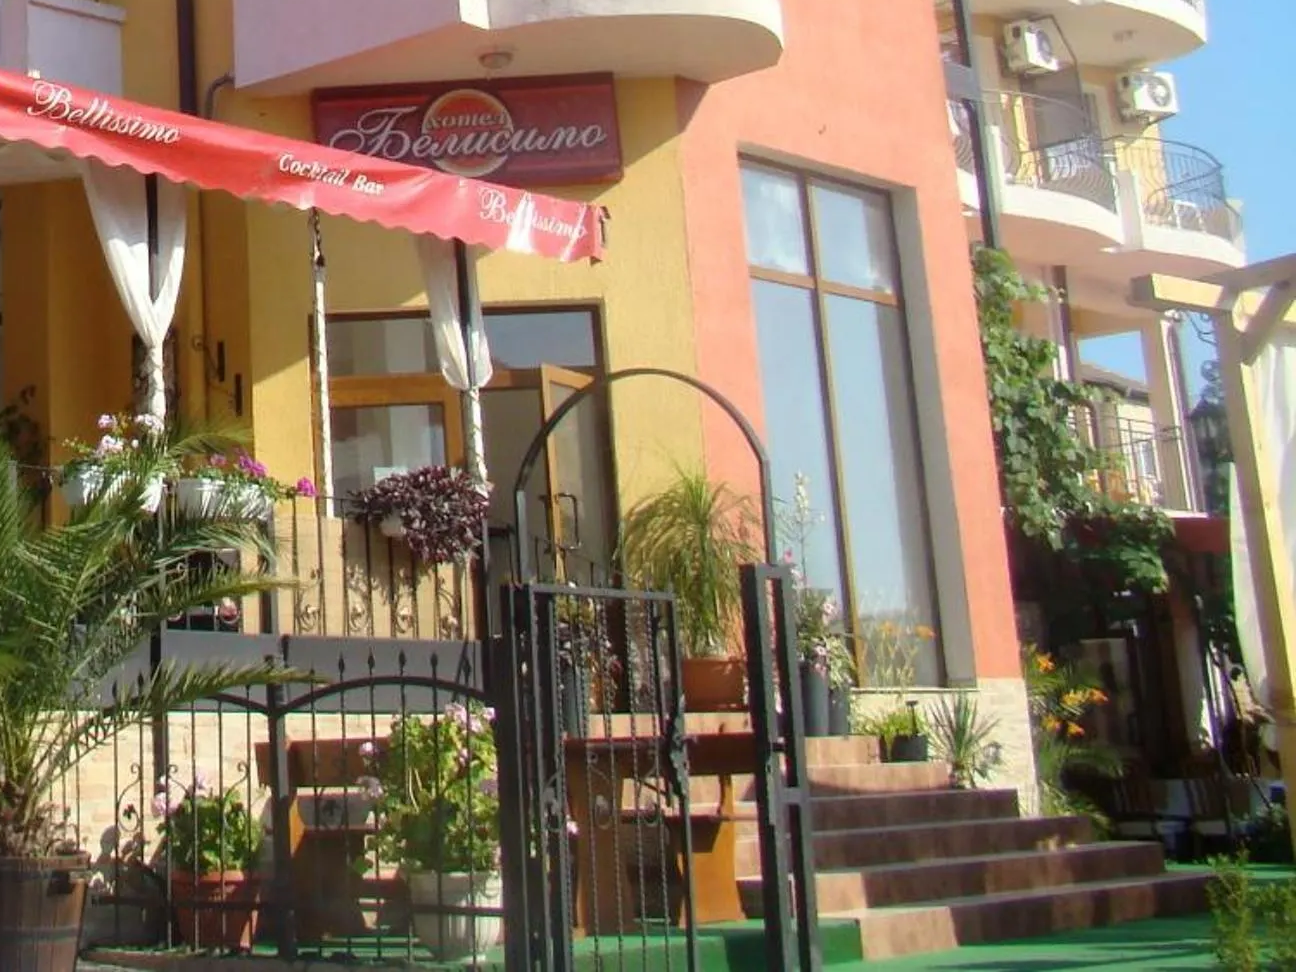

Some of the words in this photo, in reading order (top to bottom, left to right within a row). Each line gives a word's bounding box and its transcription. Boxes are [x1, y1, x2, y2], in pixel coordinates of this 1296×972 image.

[27, 80, 182, 144] Bellissimo
[279, 152, 351, 186] Cocktail
[352, 174, 385, 195] Bar
[478, 188, 587, 239] Beissimo
